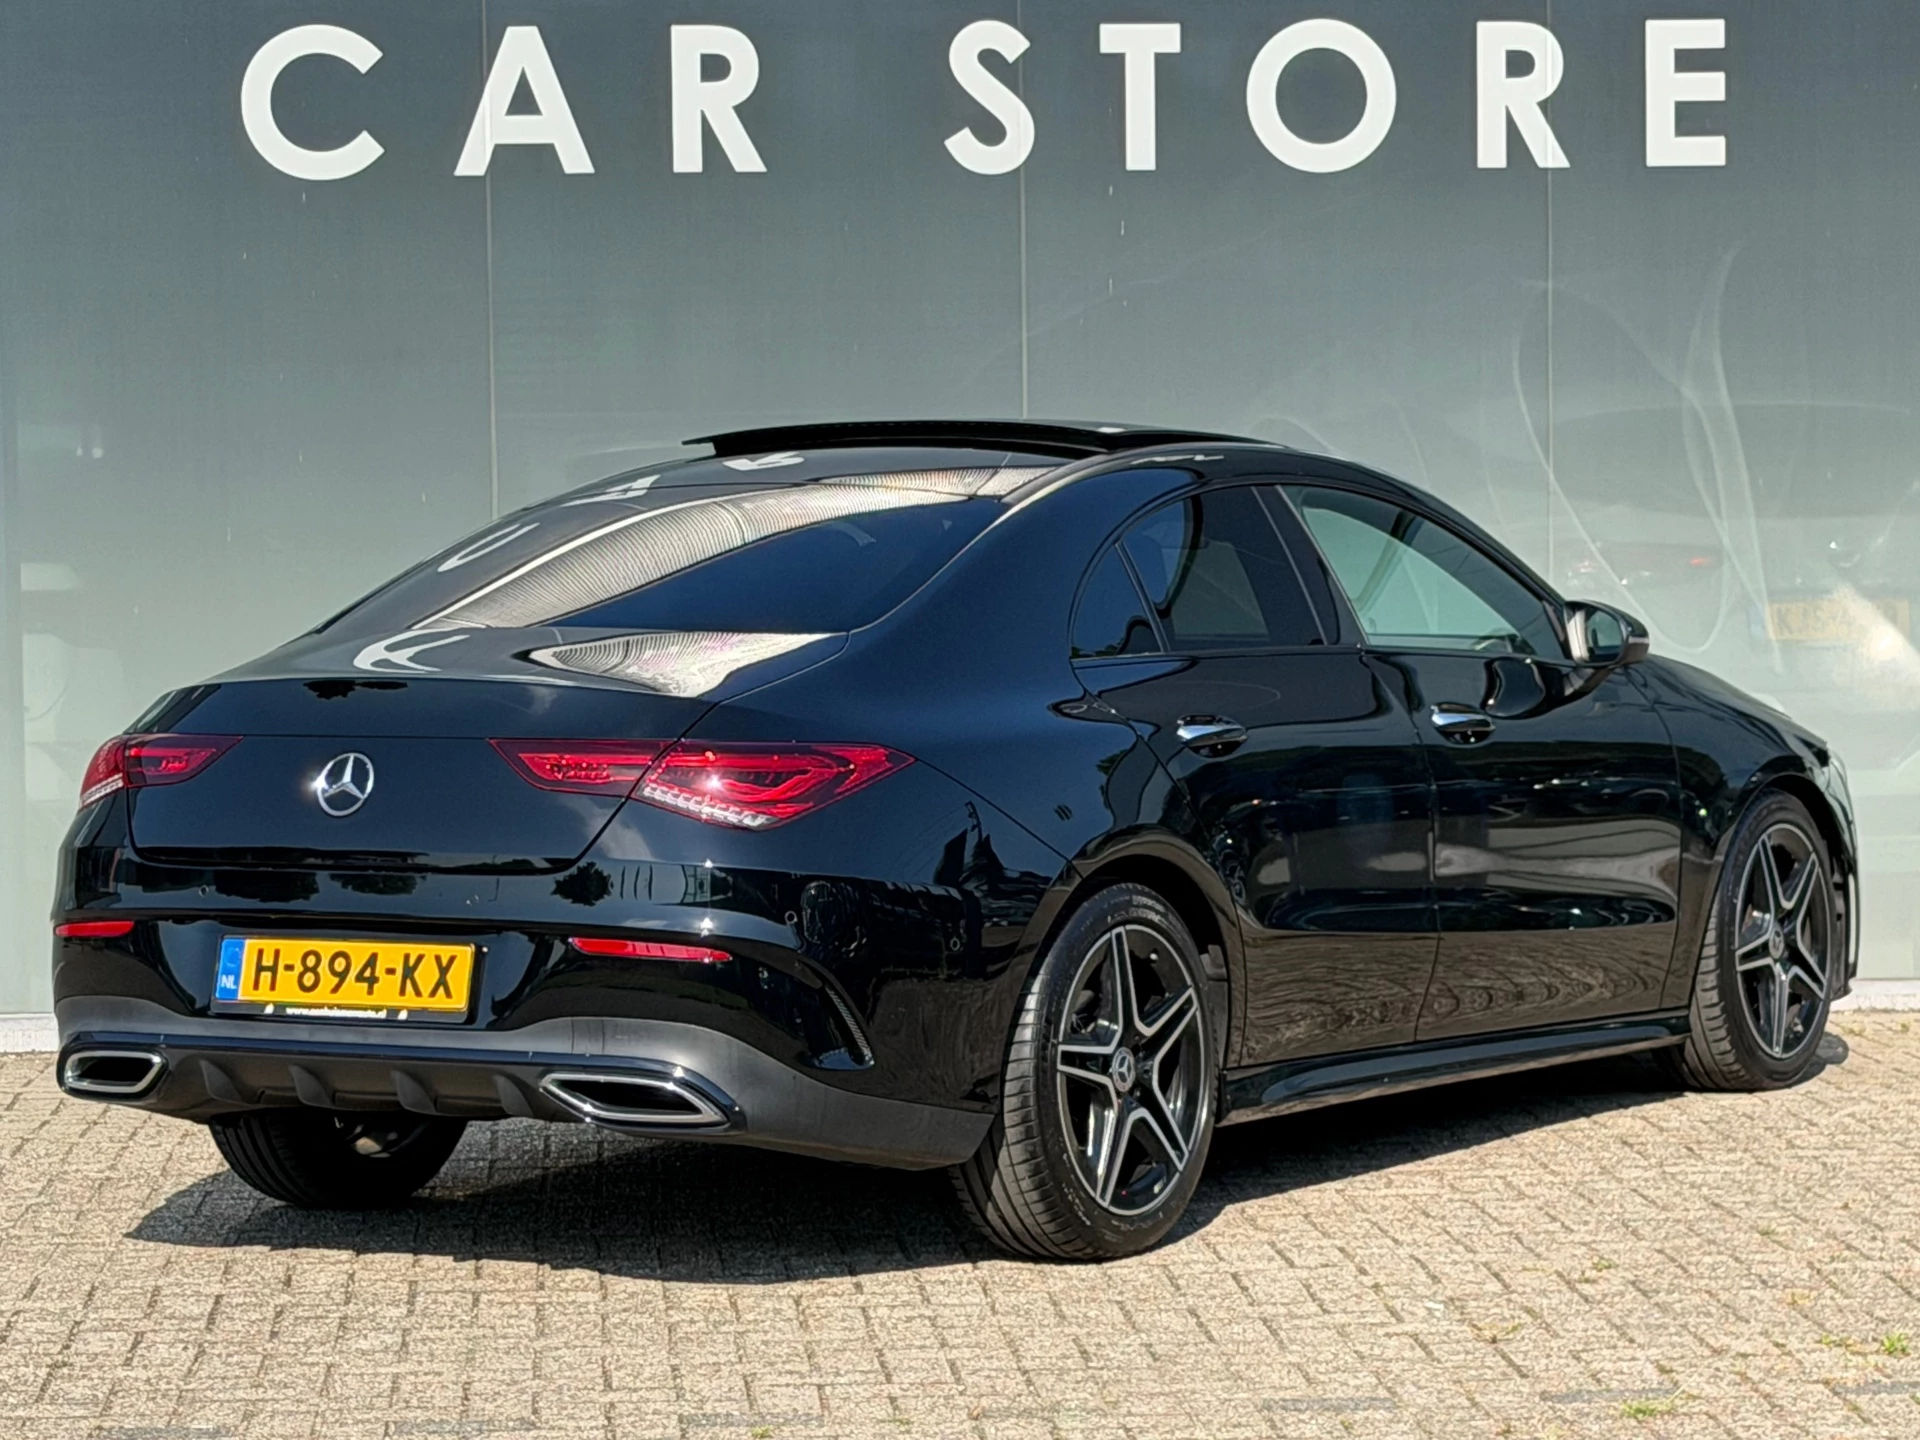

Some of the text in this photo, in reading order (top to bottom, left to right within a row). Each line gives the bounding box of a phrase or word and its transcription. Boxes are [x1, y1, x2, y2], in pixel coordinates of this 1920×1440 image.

[241, 18, 1726, 181] CAR STORE
[220, 974, 238, 990] NL
[252, 947, 458, 1000] H-894-KX
